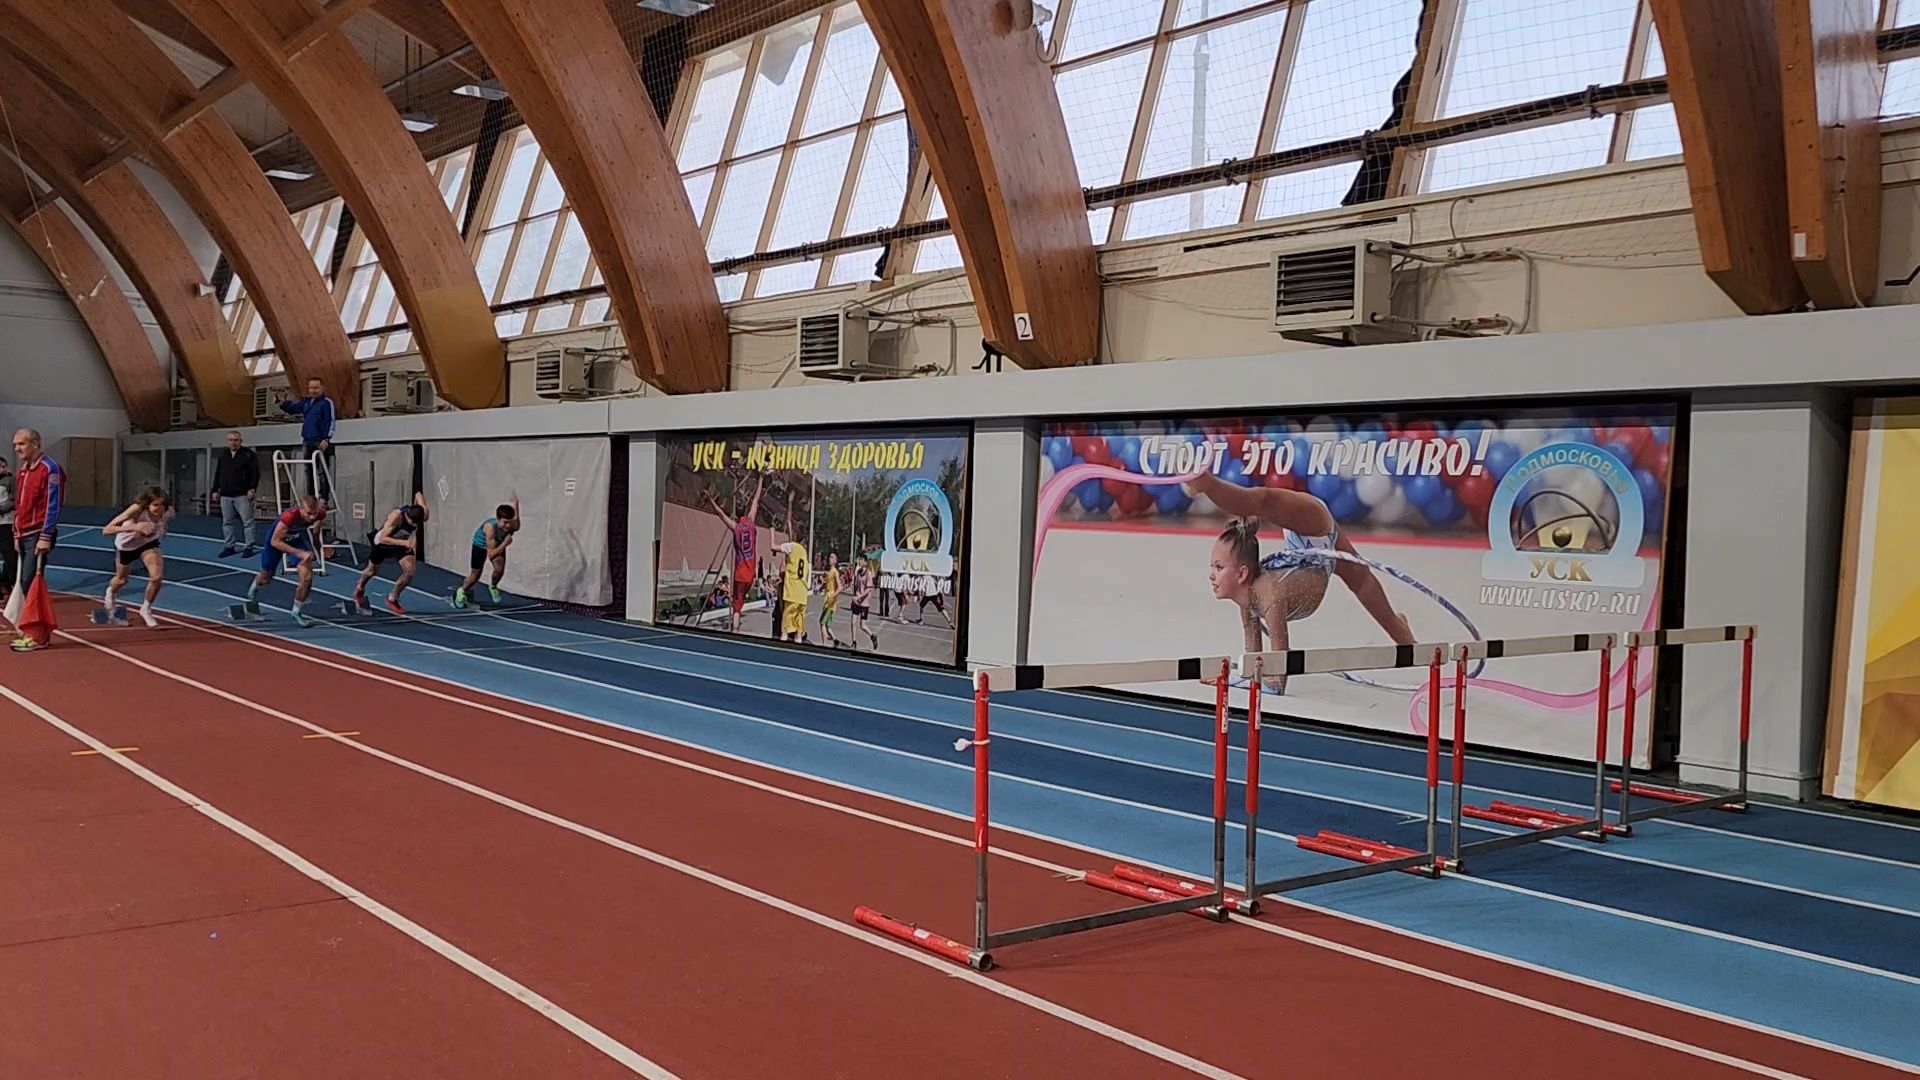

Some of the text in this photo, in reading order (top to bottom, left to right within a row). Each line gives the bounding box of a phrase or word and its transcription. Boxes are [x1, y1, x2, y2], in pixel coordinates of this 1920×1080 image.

[1017, 316, 1031, 338] 2
[692, 440, 727, 473] УСК
[746, 443, 820, 475] КУЗНИЦА
[827, 441, 925, 475] ЗДОРОВЬЯ
[1240, 439, 1295, 476] ЭТО
[1307, 429, 1493, 477] КРАСИВО!
[902, 558, 930, 572] УСК
[1530, 556, 1592, 582] УСК
[1479, 584, 1641, 615] WWW.USKP.RU
